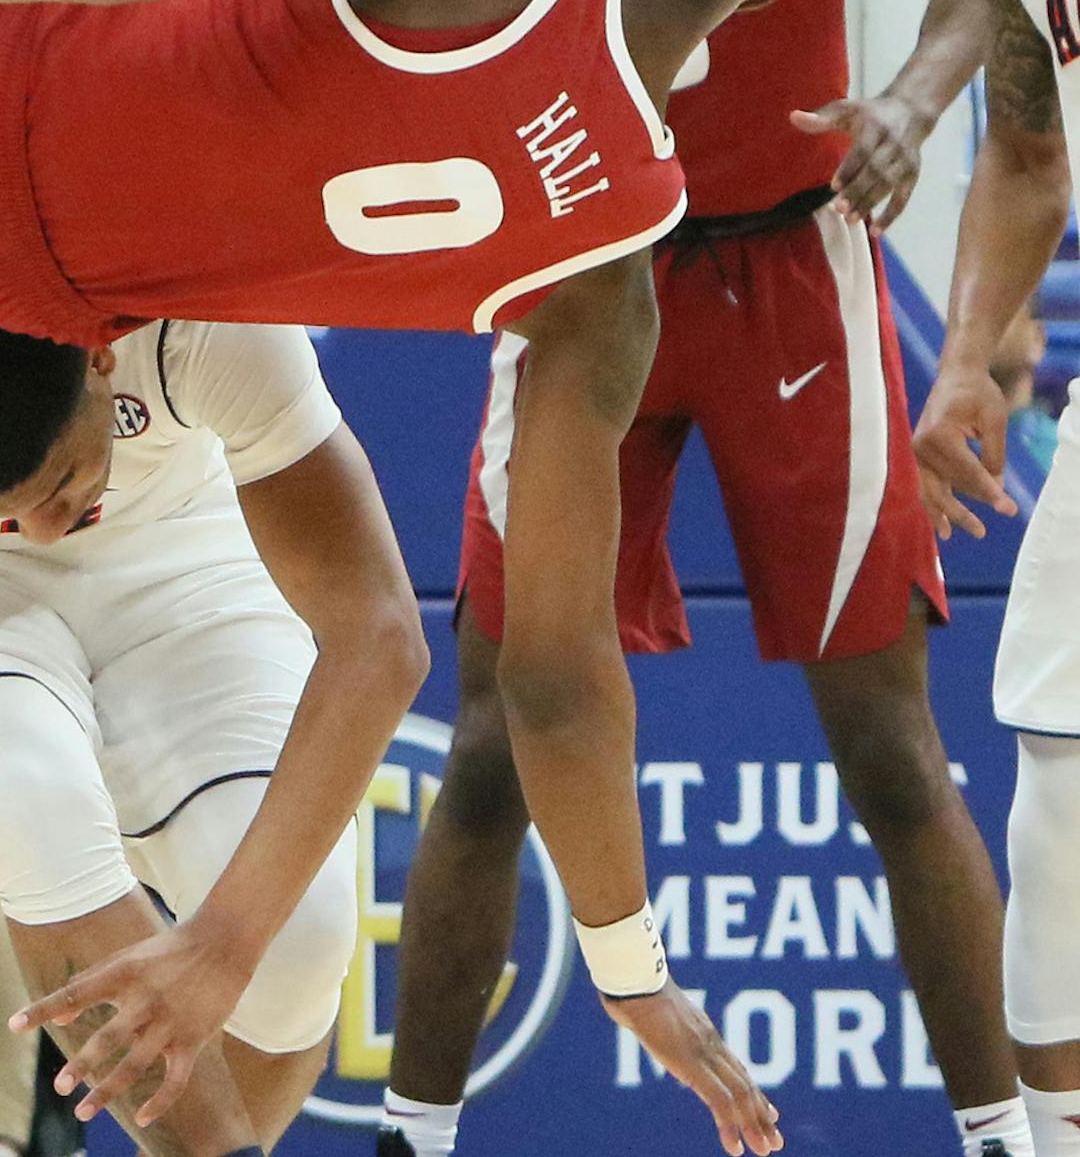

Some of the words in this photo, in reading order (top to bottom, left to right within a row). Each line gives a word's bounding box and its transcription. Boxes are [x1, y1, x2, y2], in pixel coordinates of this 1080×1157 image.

[516, 91, 610, 219] HALL
[321, 156, 505, 255] 0
[114, 398, 147, 436] EC
[636, 761, 705, 845] T
[648, 875, 896, 960] MEAN
